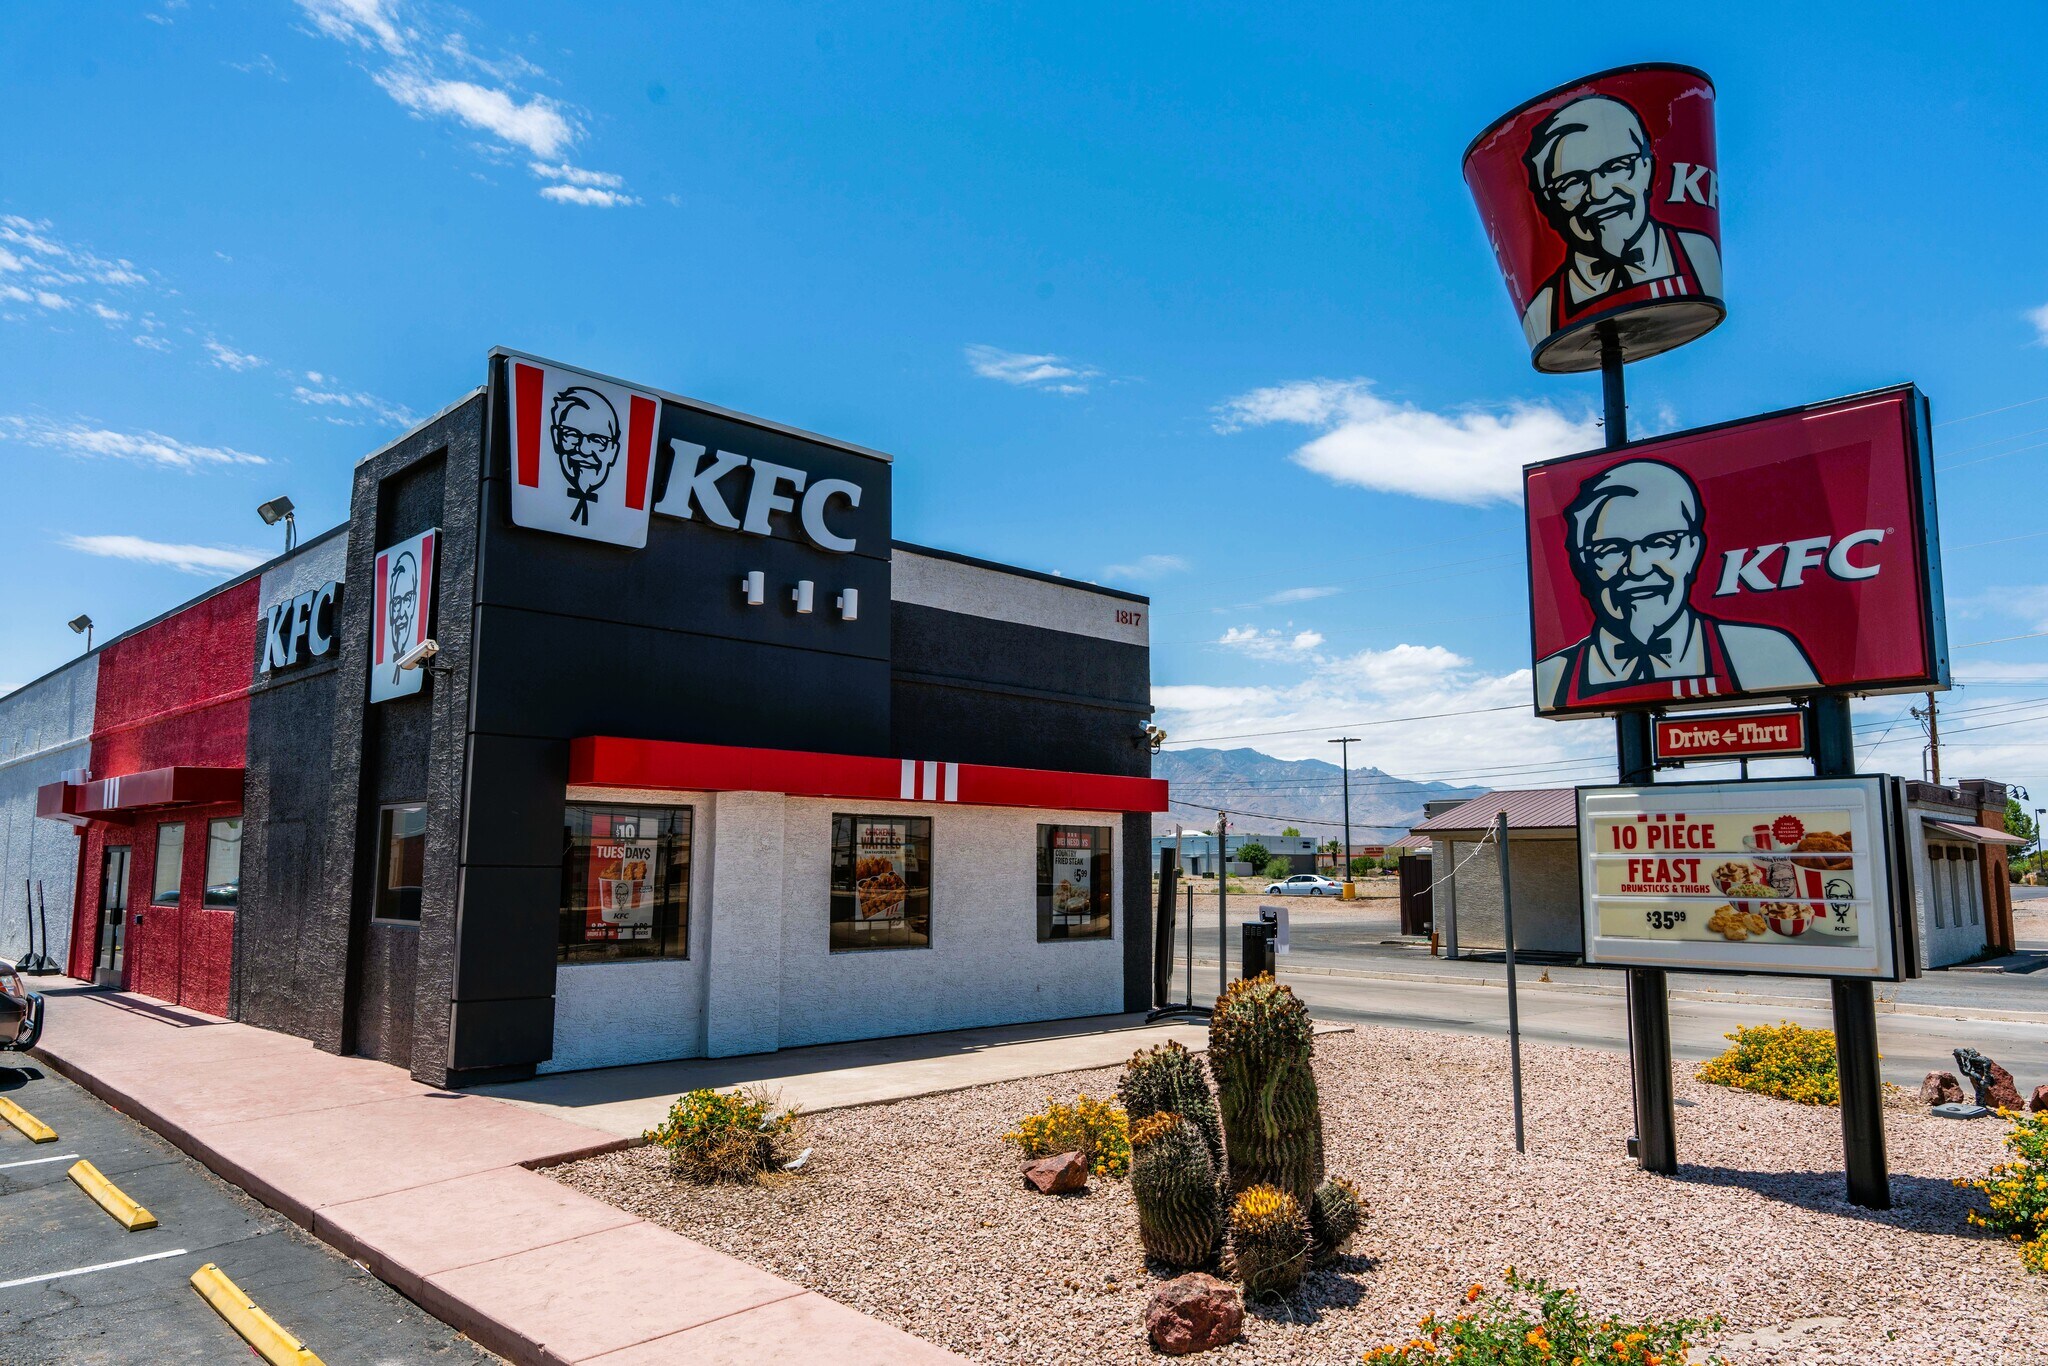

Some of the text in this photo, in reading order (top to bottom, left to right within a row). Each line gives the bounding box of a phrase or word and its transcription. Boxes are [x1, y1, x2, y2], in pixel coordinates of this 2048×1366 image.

[653, 437, 863, 552] KFC
[260, 580, 337, 673] KFC
[1115, 609, 1142, 627] 1817
[1668, 723, 1788, 749] Drive Thru
[615, 824, 636, 841] $10
[1611, 824, 1716, 850] 10 PIECE
[1069, 858, 1084, 866] STEAK
[1628, 859, 1701, 883] FEAST
[1621, 884, 1710, 893] DRUMSTICKS & THIGHS
[613, 912, 629, 920] KFC
